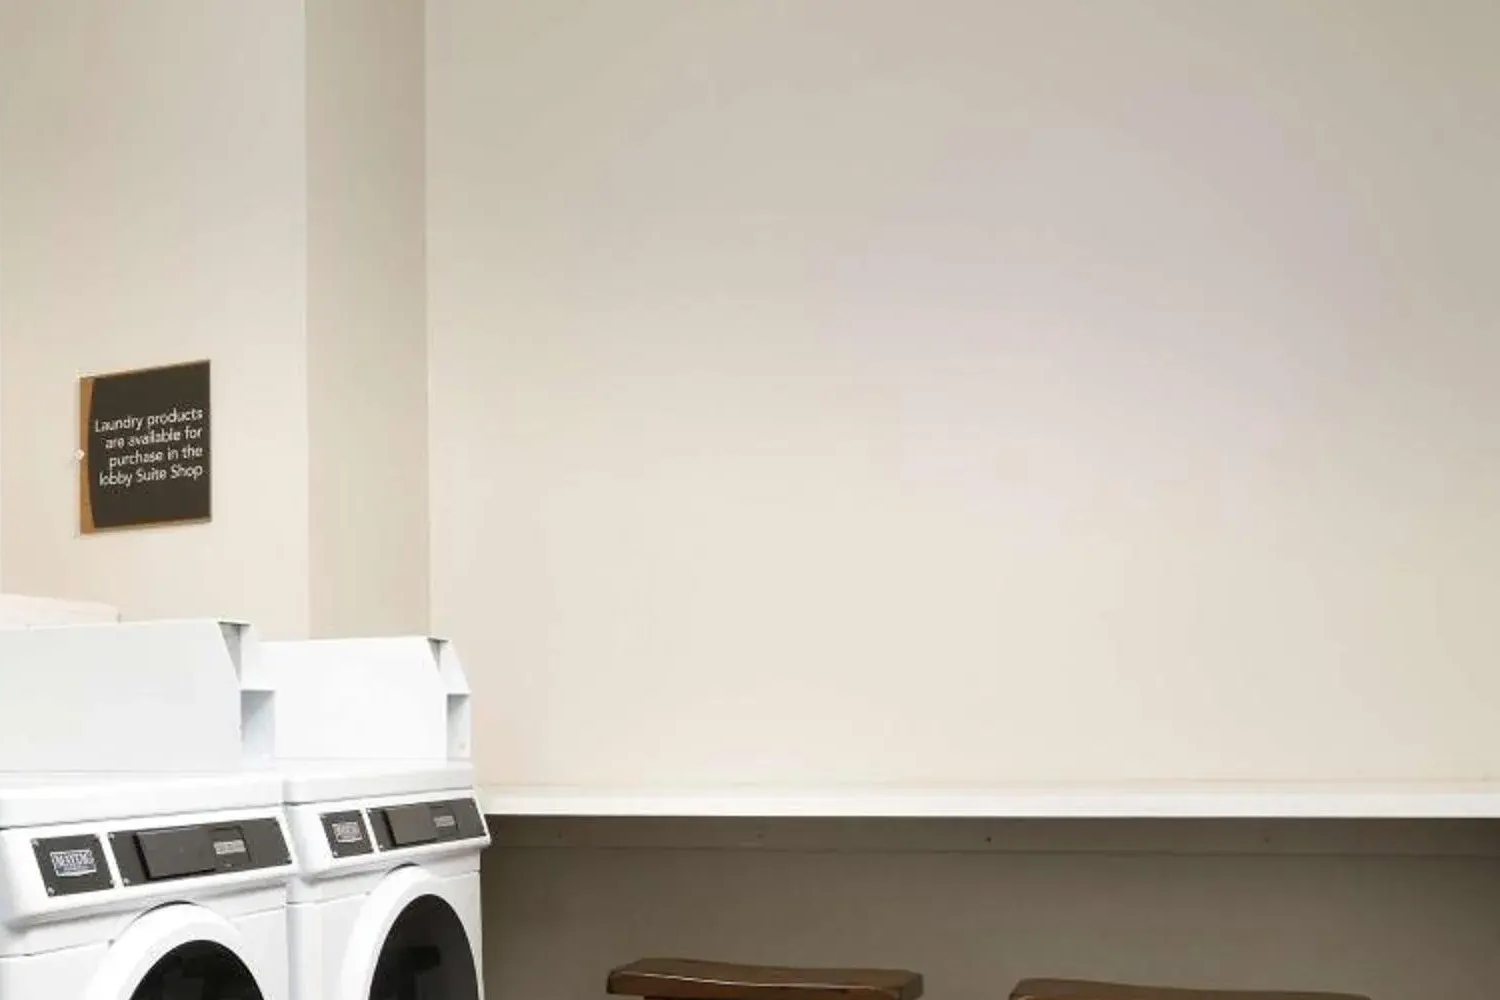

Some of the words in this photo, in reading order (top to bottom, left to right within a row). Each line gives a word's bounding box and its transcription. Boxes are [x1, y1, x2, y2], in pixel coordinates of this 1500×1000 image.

[95, 415, 144, 433] Laundry
[147, 407, 203, 429] products
[105, 438, 125, 449] are
[128, 428, 181, 447] available
[185, 426, 202, 439] for
[109, 450, 164, 469] purchase
[167, 447, 179, 460] in
[182, 444, 203, 458] the
[99, 471, 133, 487] lobby
[135, 468, 167, 482] Suite
[171, 464, 203, 480] Shop
